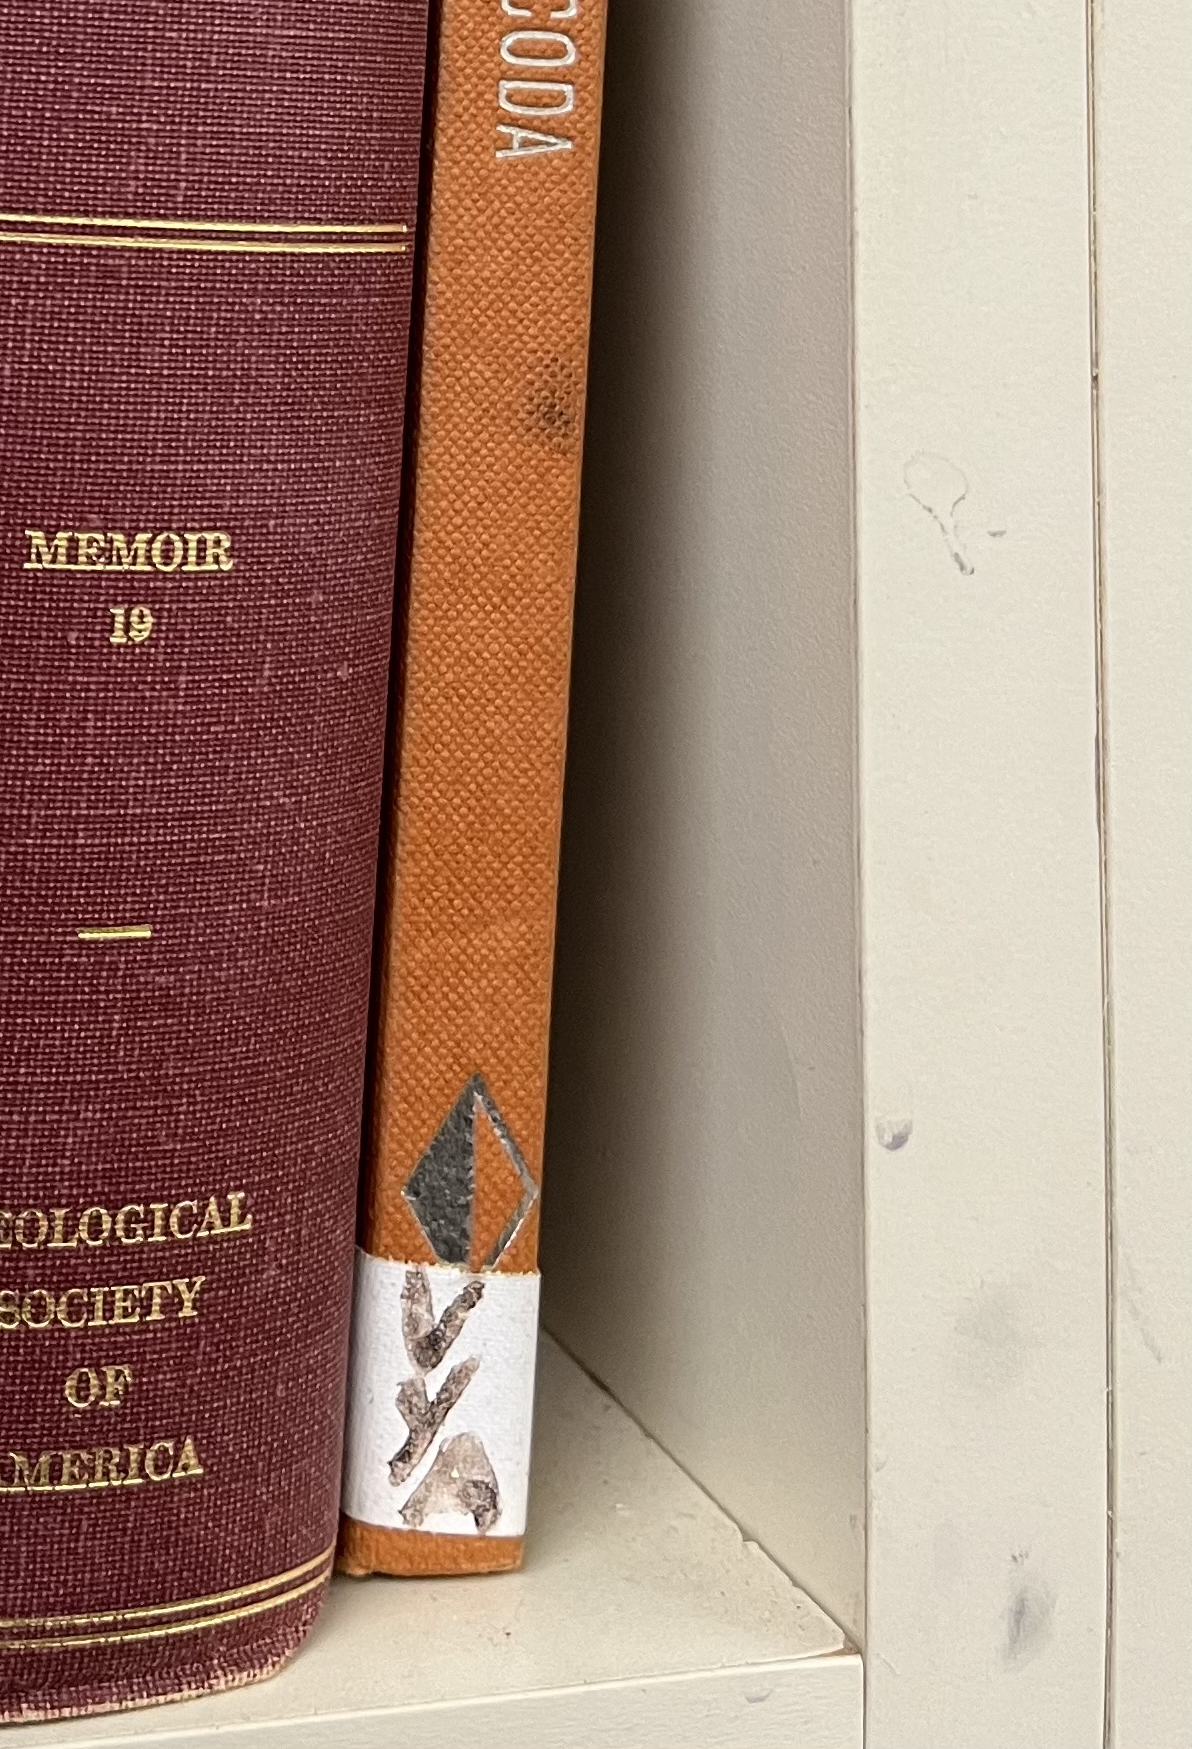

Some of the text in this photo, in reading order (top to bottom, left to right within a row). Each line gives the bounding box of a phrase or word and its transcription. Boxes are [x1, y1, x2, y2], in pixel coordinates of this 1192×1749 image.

[22, 529, 234, 572] MEMOIR
[109, 605, 154, 644] 19
[64, 1363, 134, 1408] OF
